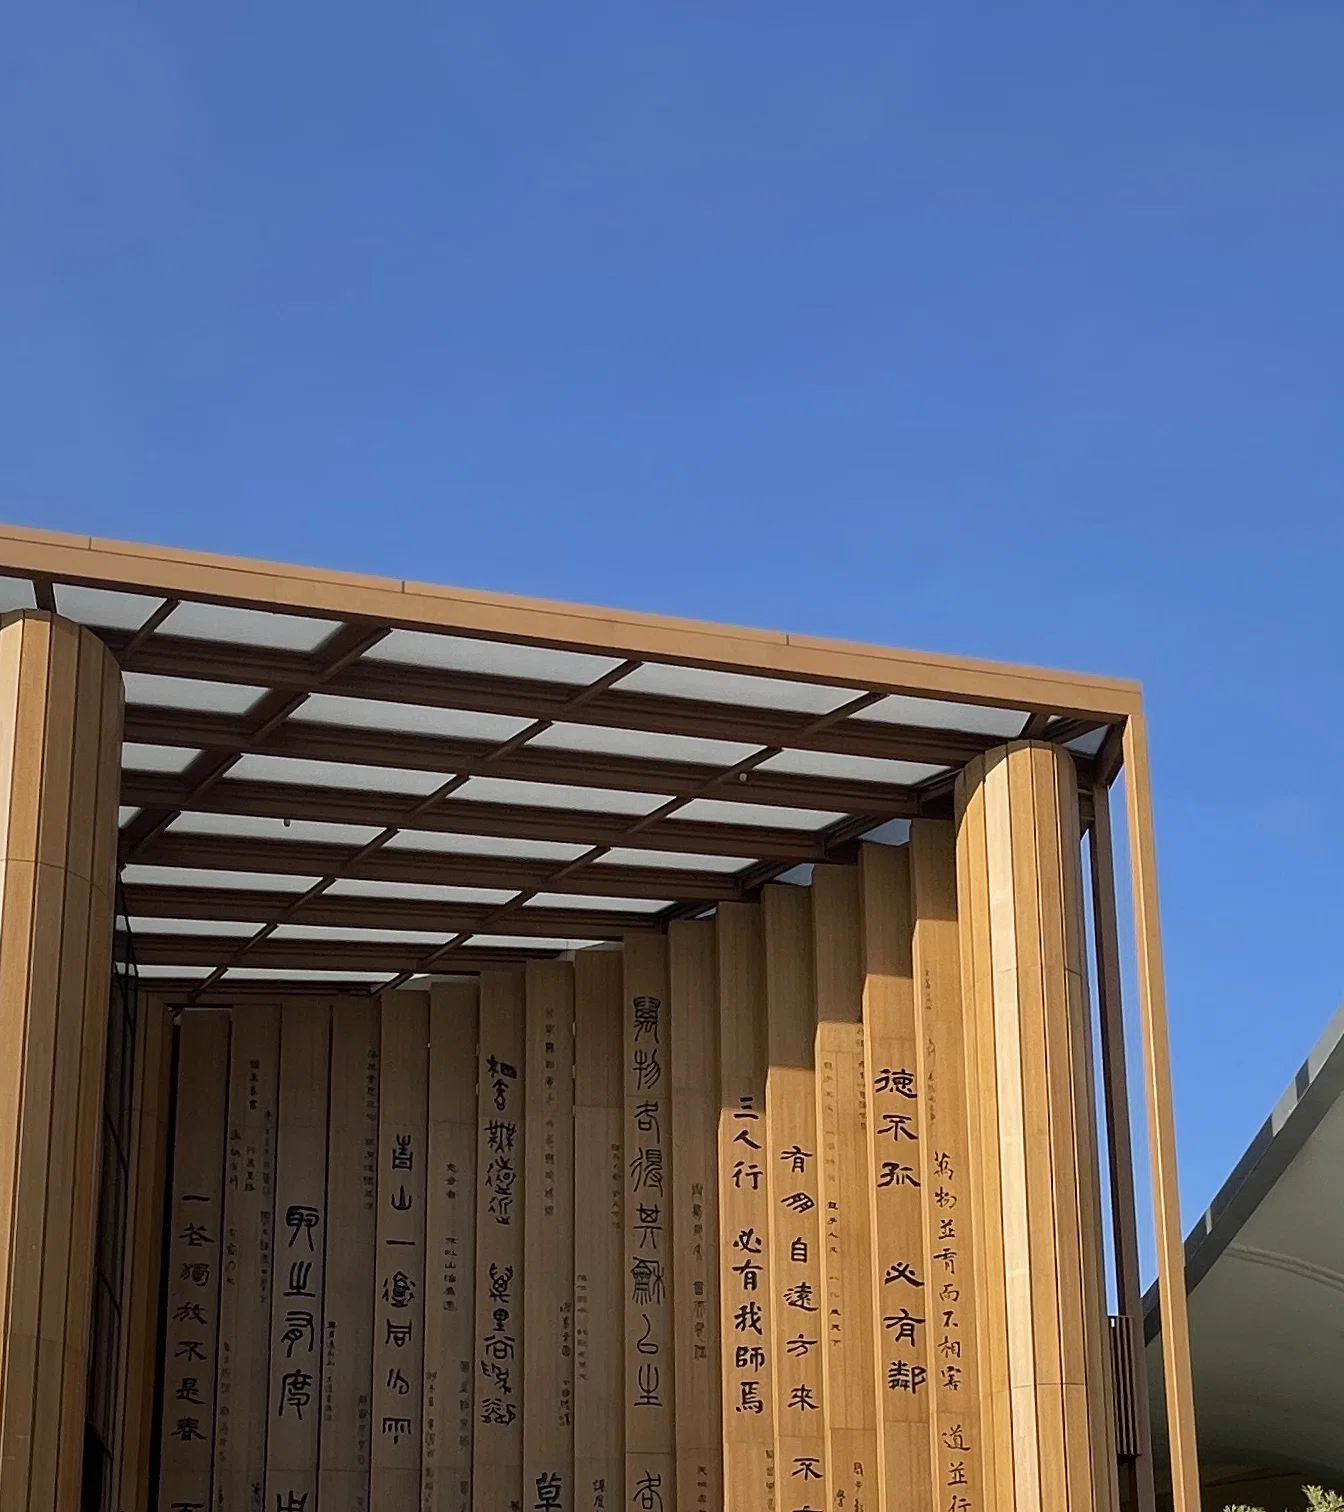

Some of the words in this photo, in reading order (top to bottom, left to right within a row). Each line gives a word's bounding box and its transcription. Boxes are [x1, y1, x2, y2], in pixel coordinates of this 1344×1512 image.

[732, 1097, 764, 1190] 三人行
[171, 1194, 215, 1442] 一花獨放不是春
[278, 1205, 320, 1421] 取之有度
[732, 1228, 765, 1414] 必有我師焉
